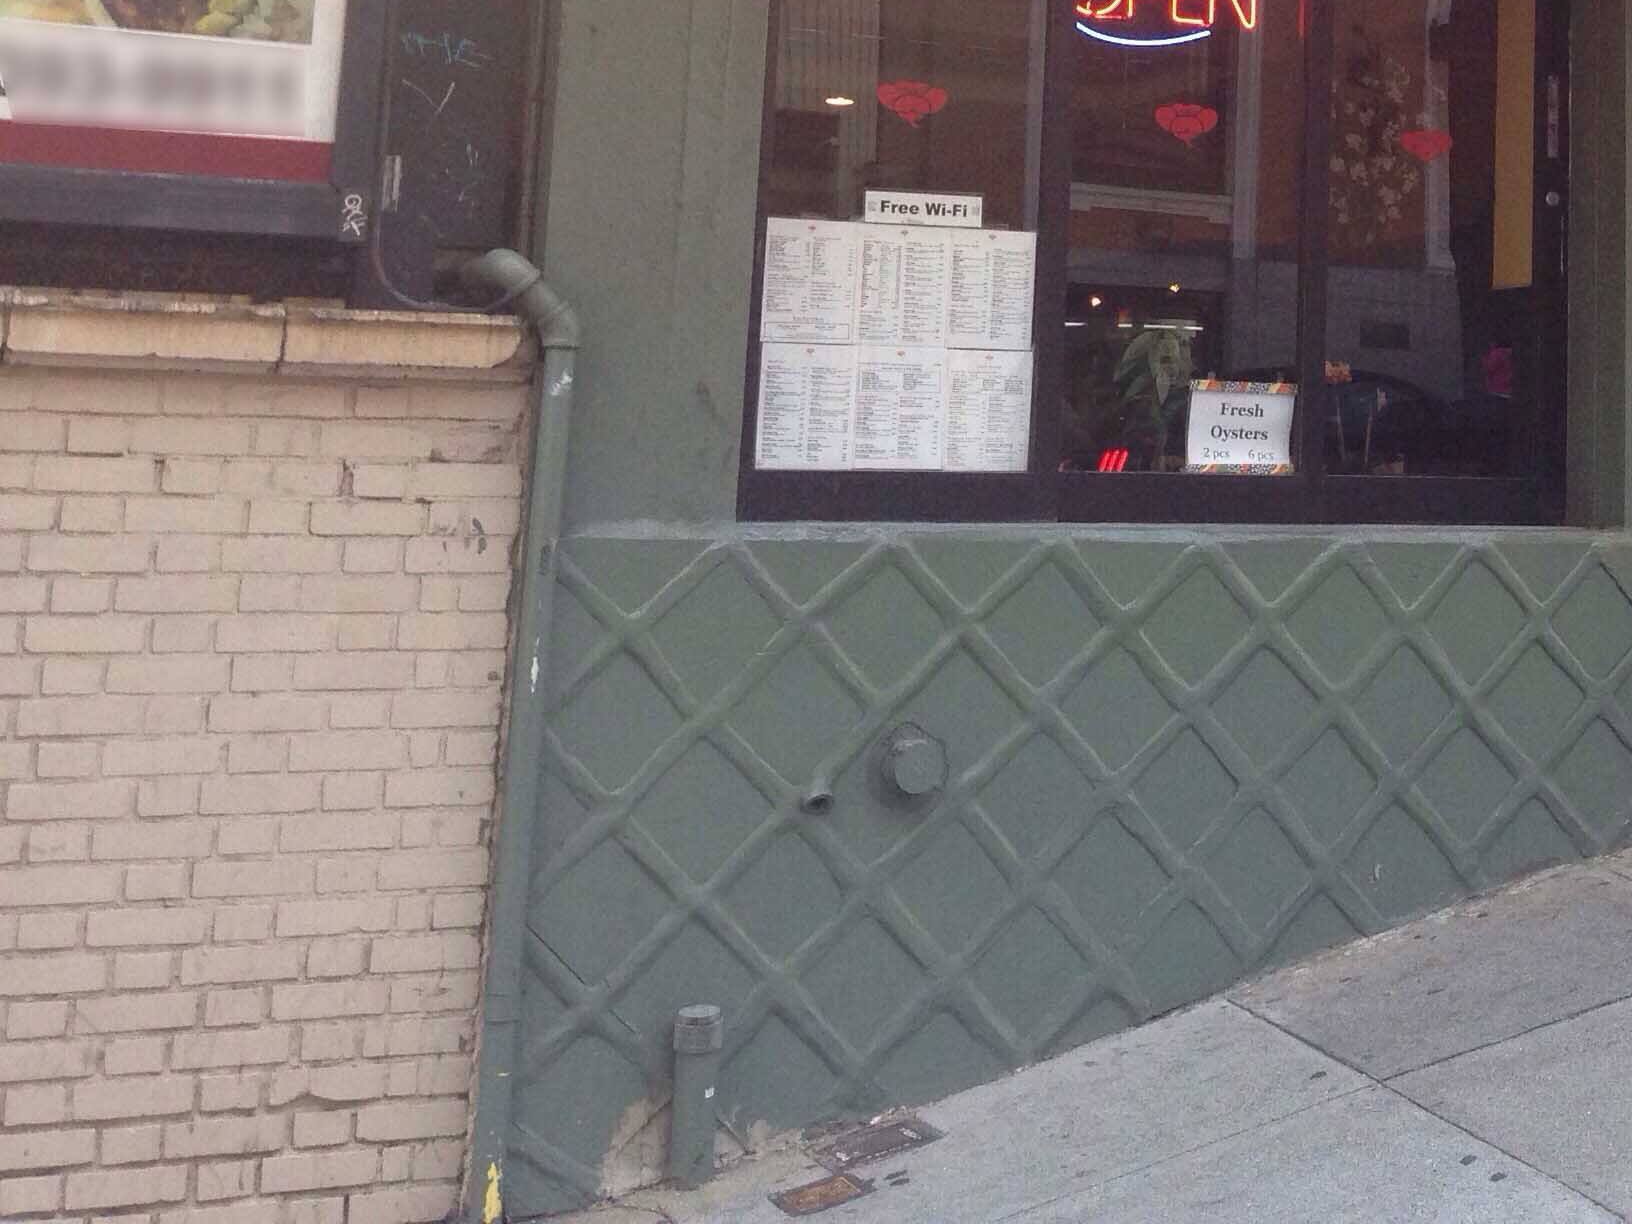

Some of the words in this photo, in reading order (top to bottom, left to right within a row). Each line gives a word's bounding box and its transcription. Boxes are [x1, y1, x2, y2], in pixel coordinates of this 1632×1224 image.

[880, 200, 919, 214] Free
[925, 202, 967, 217] Wi-Fi
[1220, 403, 1265, 417] Fresh
[1210, 425, 1269, 442] Oysters
